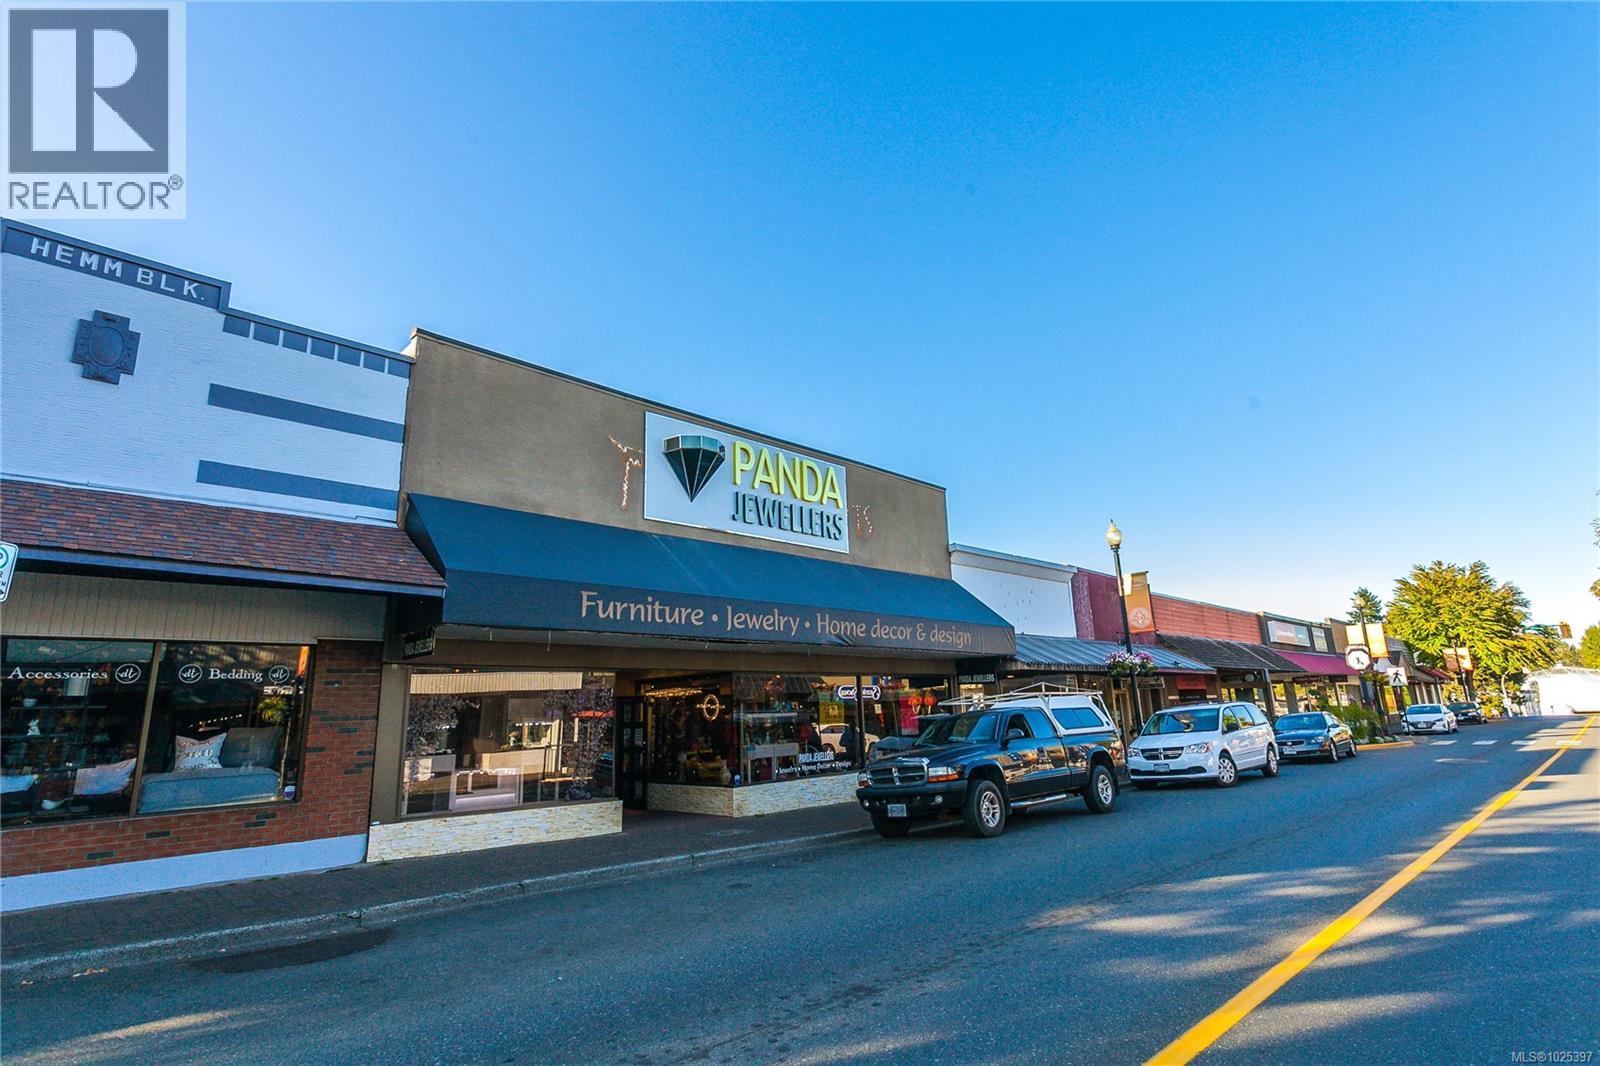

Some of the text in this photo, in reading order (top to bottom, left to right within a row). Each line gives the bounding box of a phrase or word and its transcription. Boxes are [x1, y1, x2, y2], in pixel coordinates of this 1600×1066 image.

[30, 237, 205, 301] HEMM BLK.
[732, 440, 844, 509] PANDA
[732, 491, 844, 541] JEWELLERS
[580, 590, 972, 649] Furniture Jewelry Home decor & design
[7, 666, 108, 680] Accessories
[208, 667, 263, 682] Bedding
